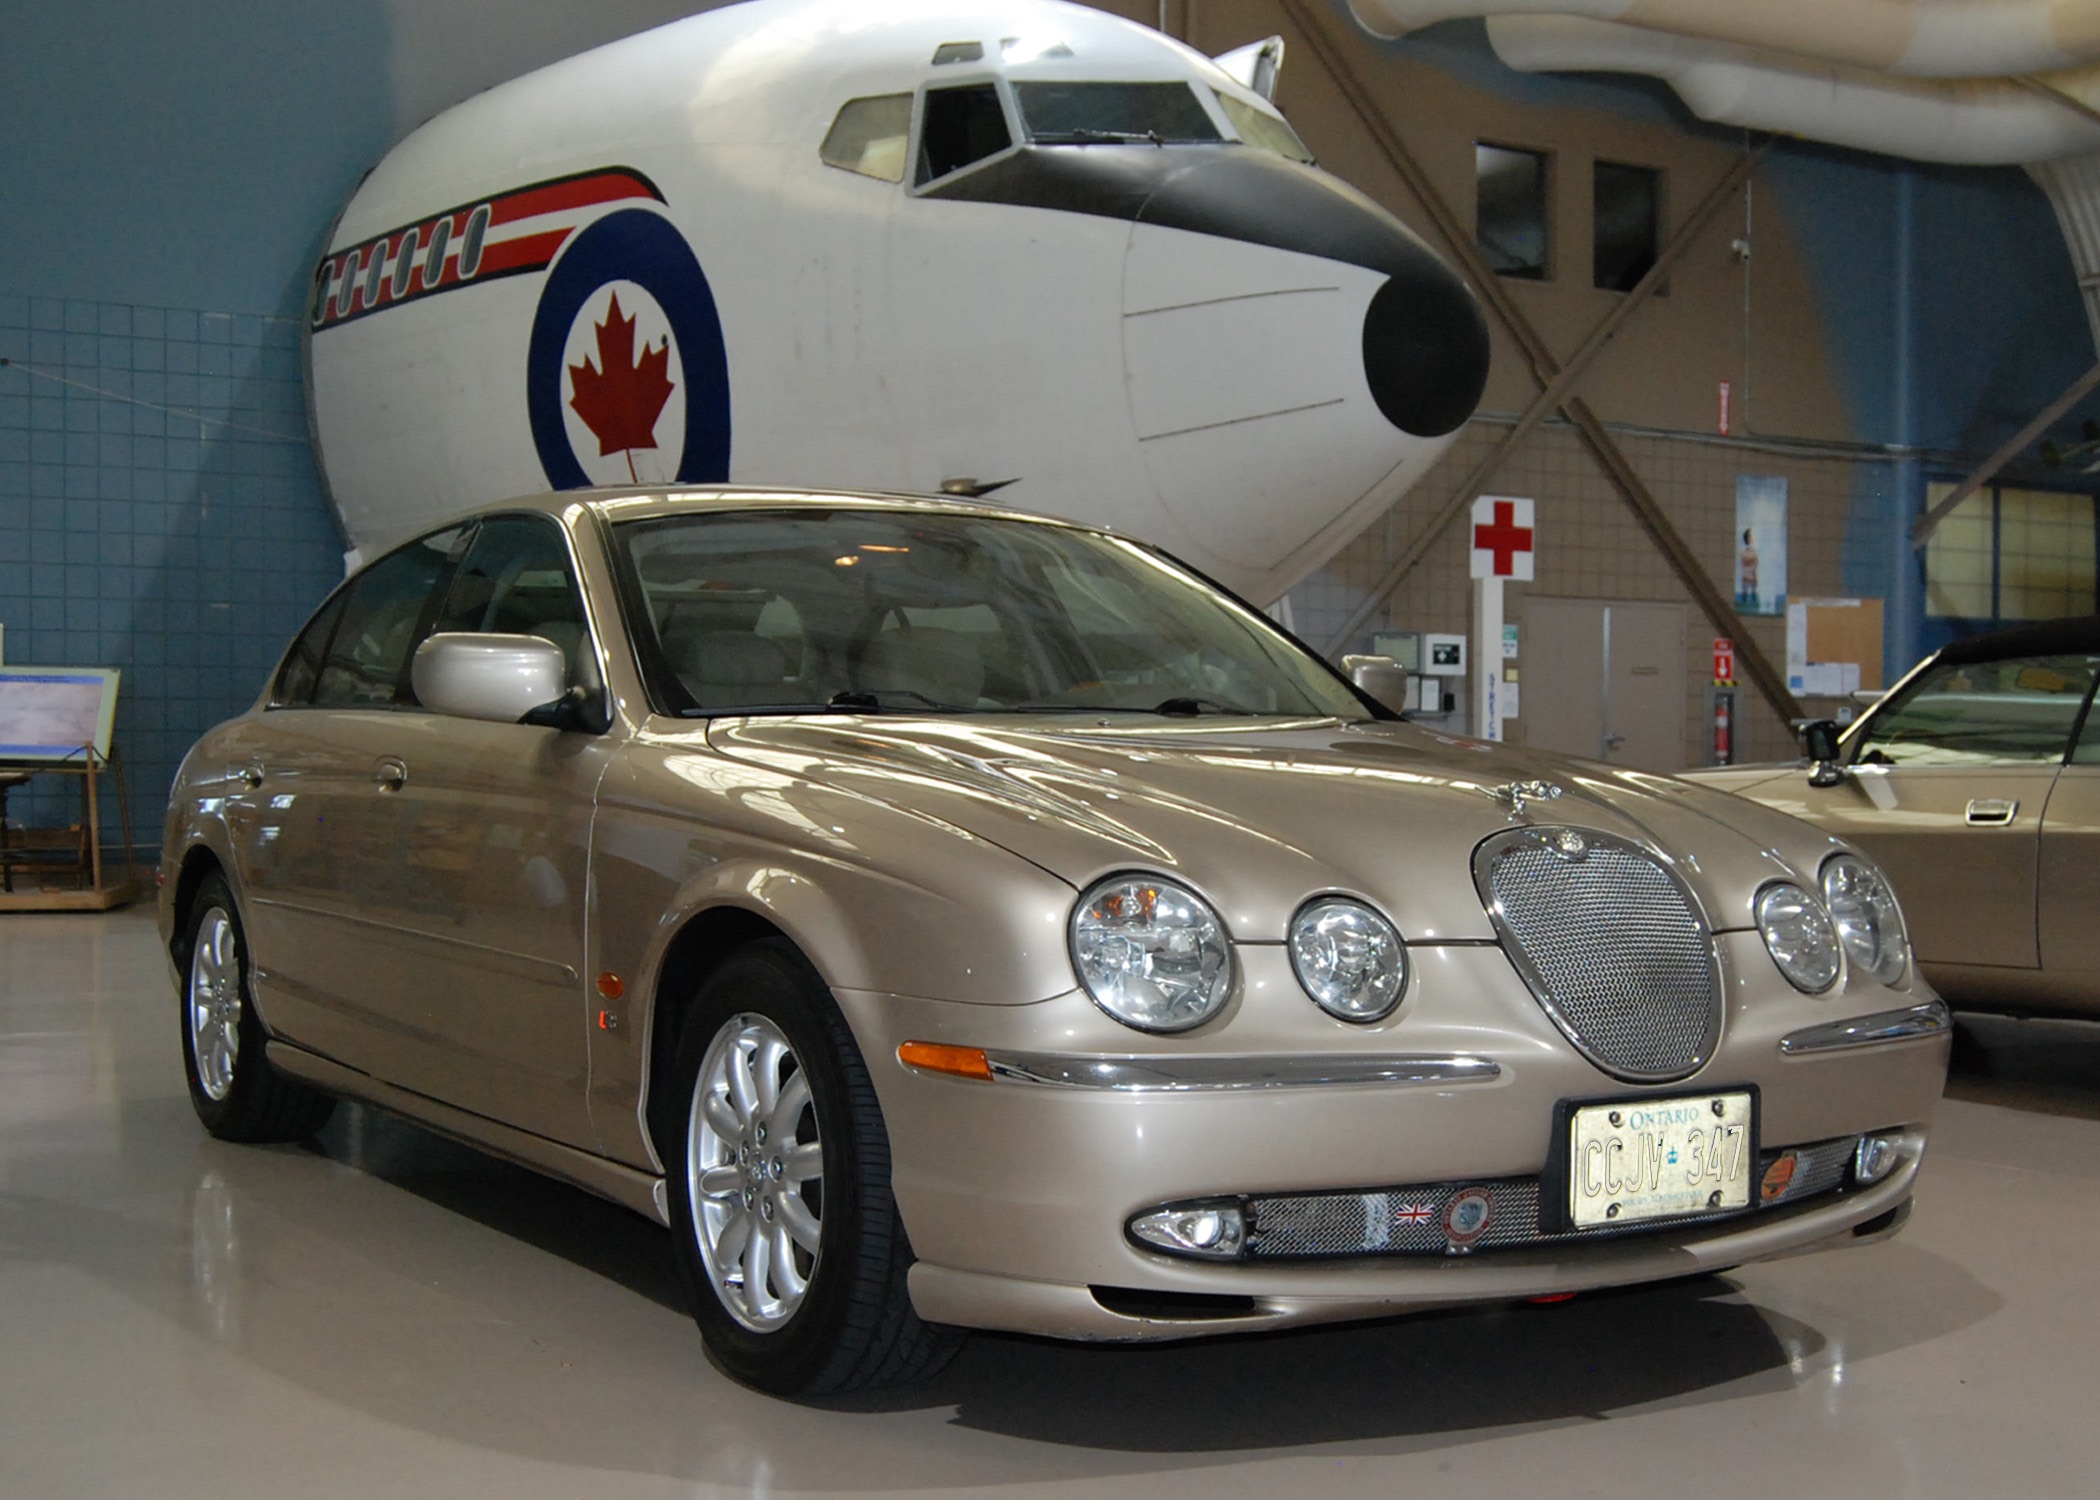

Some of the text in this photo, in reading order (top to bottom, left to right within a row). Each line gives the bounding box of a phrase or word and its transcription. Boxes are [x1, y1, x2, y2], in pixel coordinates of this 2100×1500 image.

[1630, 1107, 1699, 1130] ONTARIO
[1583, 1124, 1744, 1197] CCJV 347
